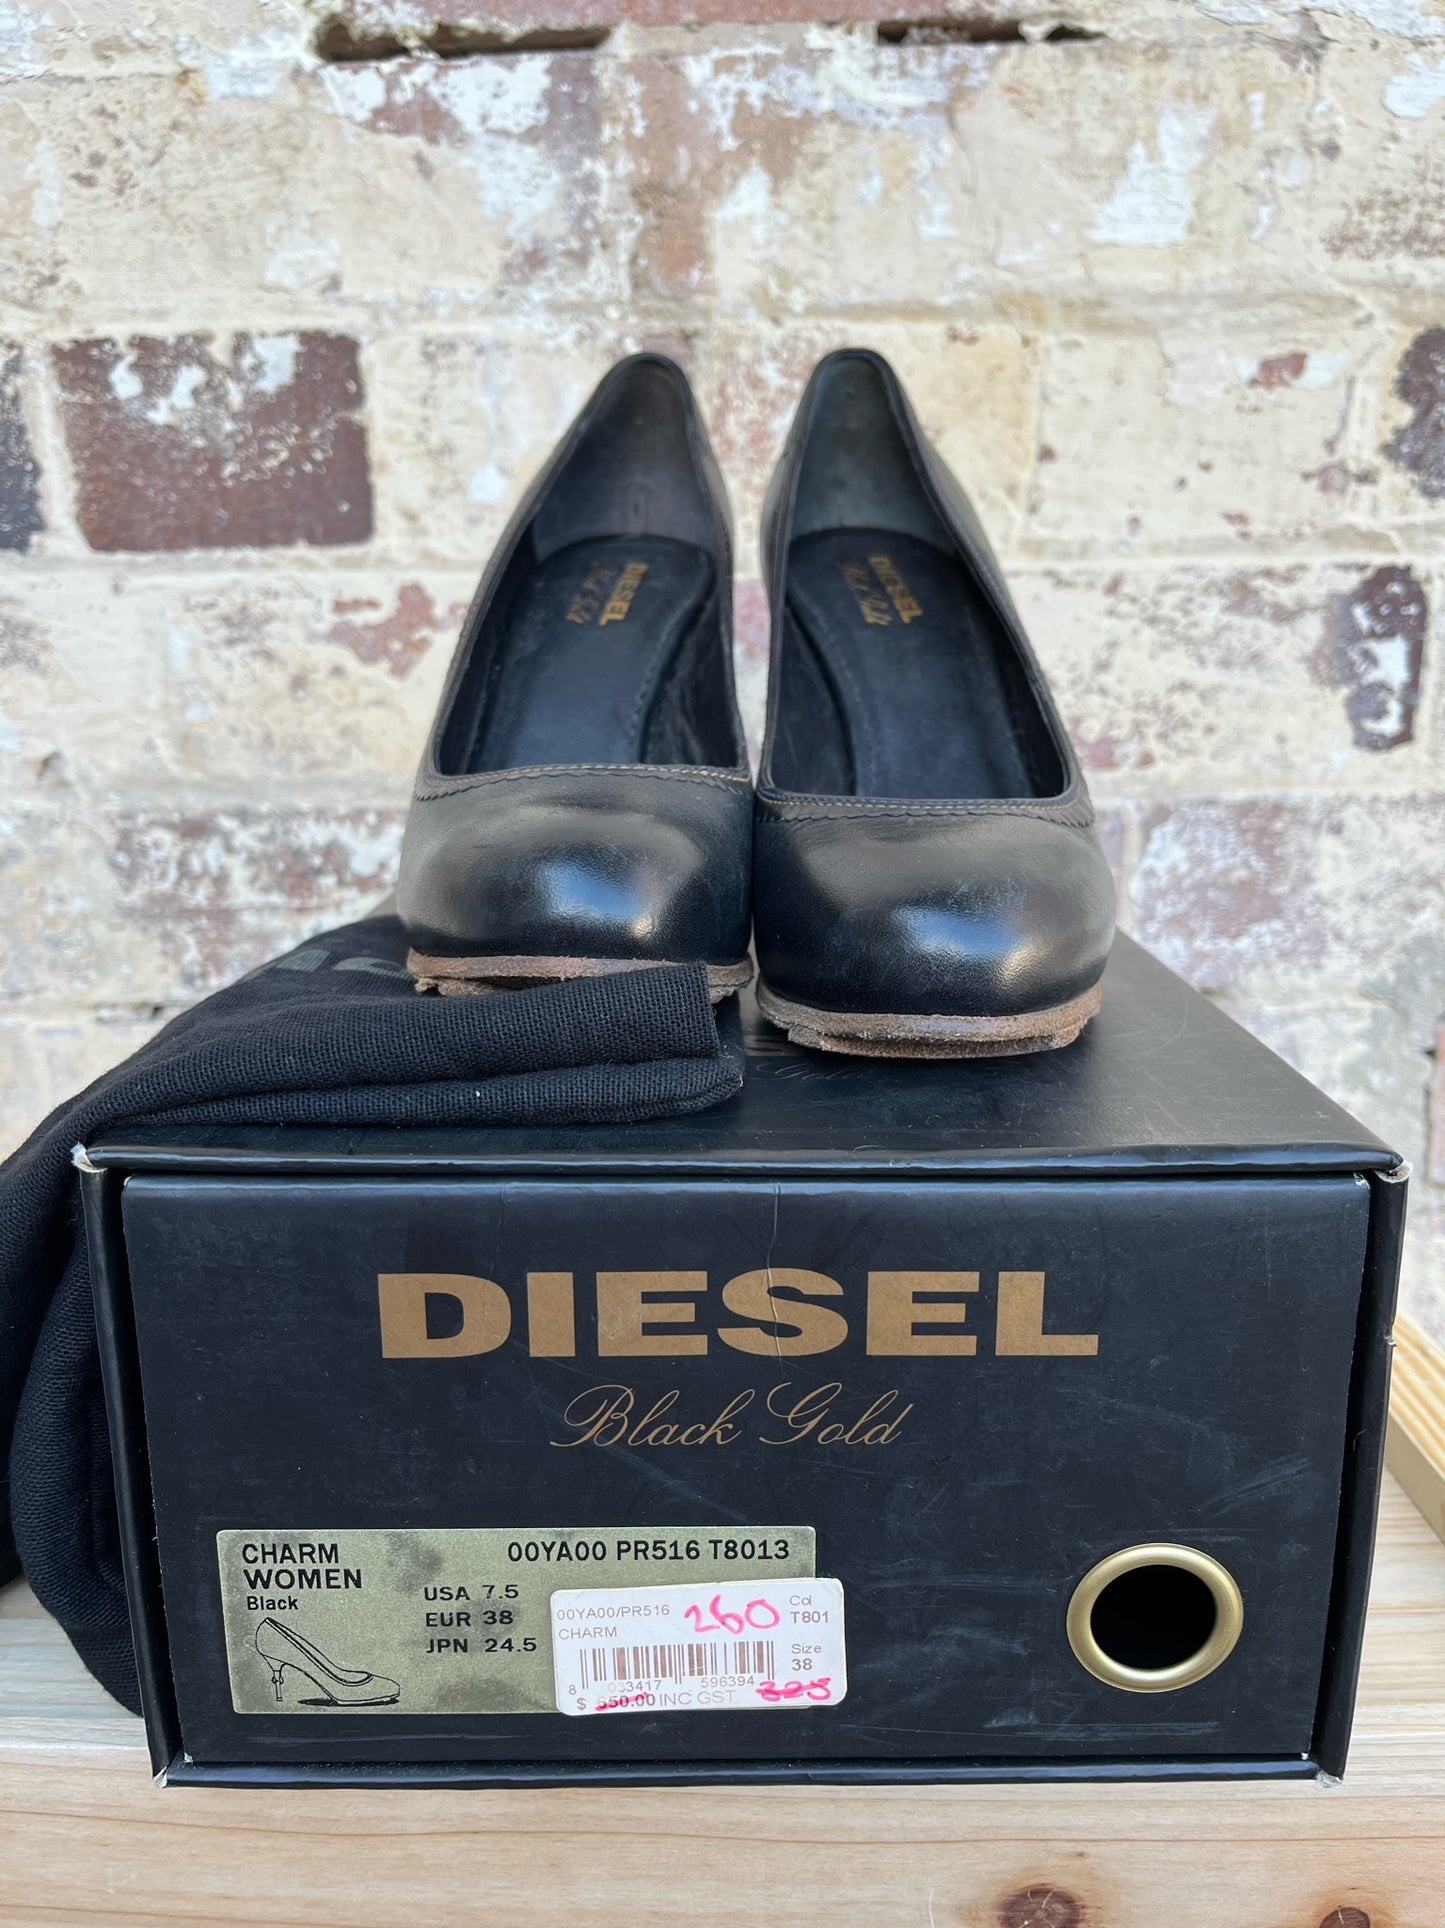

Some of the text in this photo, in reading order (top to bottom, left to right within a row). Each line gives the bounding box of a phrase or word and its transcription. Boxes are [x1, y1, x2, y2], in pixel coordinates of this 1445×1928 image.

[598, 560, 649, 626] DIESEL
[378, 1268, 1099, 1359] DIESEL
[550, 1382, 914, 1446] Black Gold
[242, 1543, 339, 1564] CHARM
[508, 1539, 789, 1561] 00YA00 PR516 T8013
[243, 1568, 362, 1589] WOMEN
[424, 1584, 519, 1600] USA 7.5
[247, 1595, 299, 1610] Black
[425, 1610, 513, 1627] EUR 38
[557, 1604, 670, 1621] 00YA00/PR516
[684, 1594, 780, 1635] 260
[790, 1611, 829, 1623] T801
[558, 1626, 617, 1640] CHARM
[426, 1637, 537, 1653] JPN 24.5
[791, 1643, 822, 1654] Size
[792, 1658, 812, 1671] 38
[568, 1684, 577, 1695] 8
[700, 1675, 754, 1689] 596394
[577, 1697, 587, 1711] $
[660, 1691, 692, 1706] INC
[697, 1689, 736, 1705] GST
